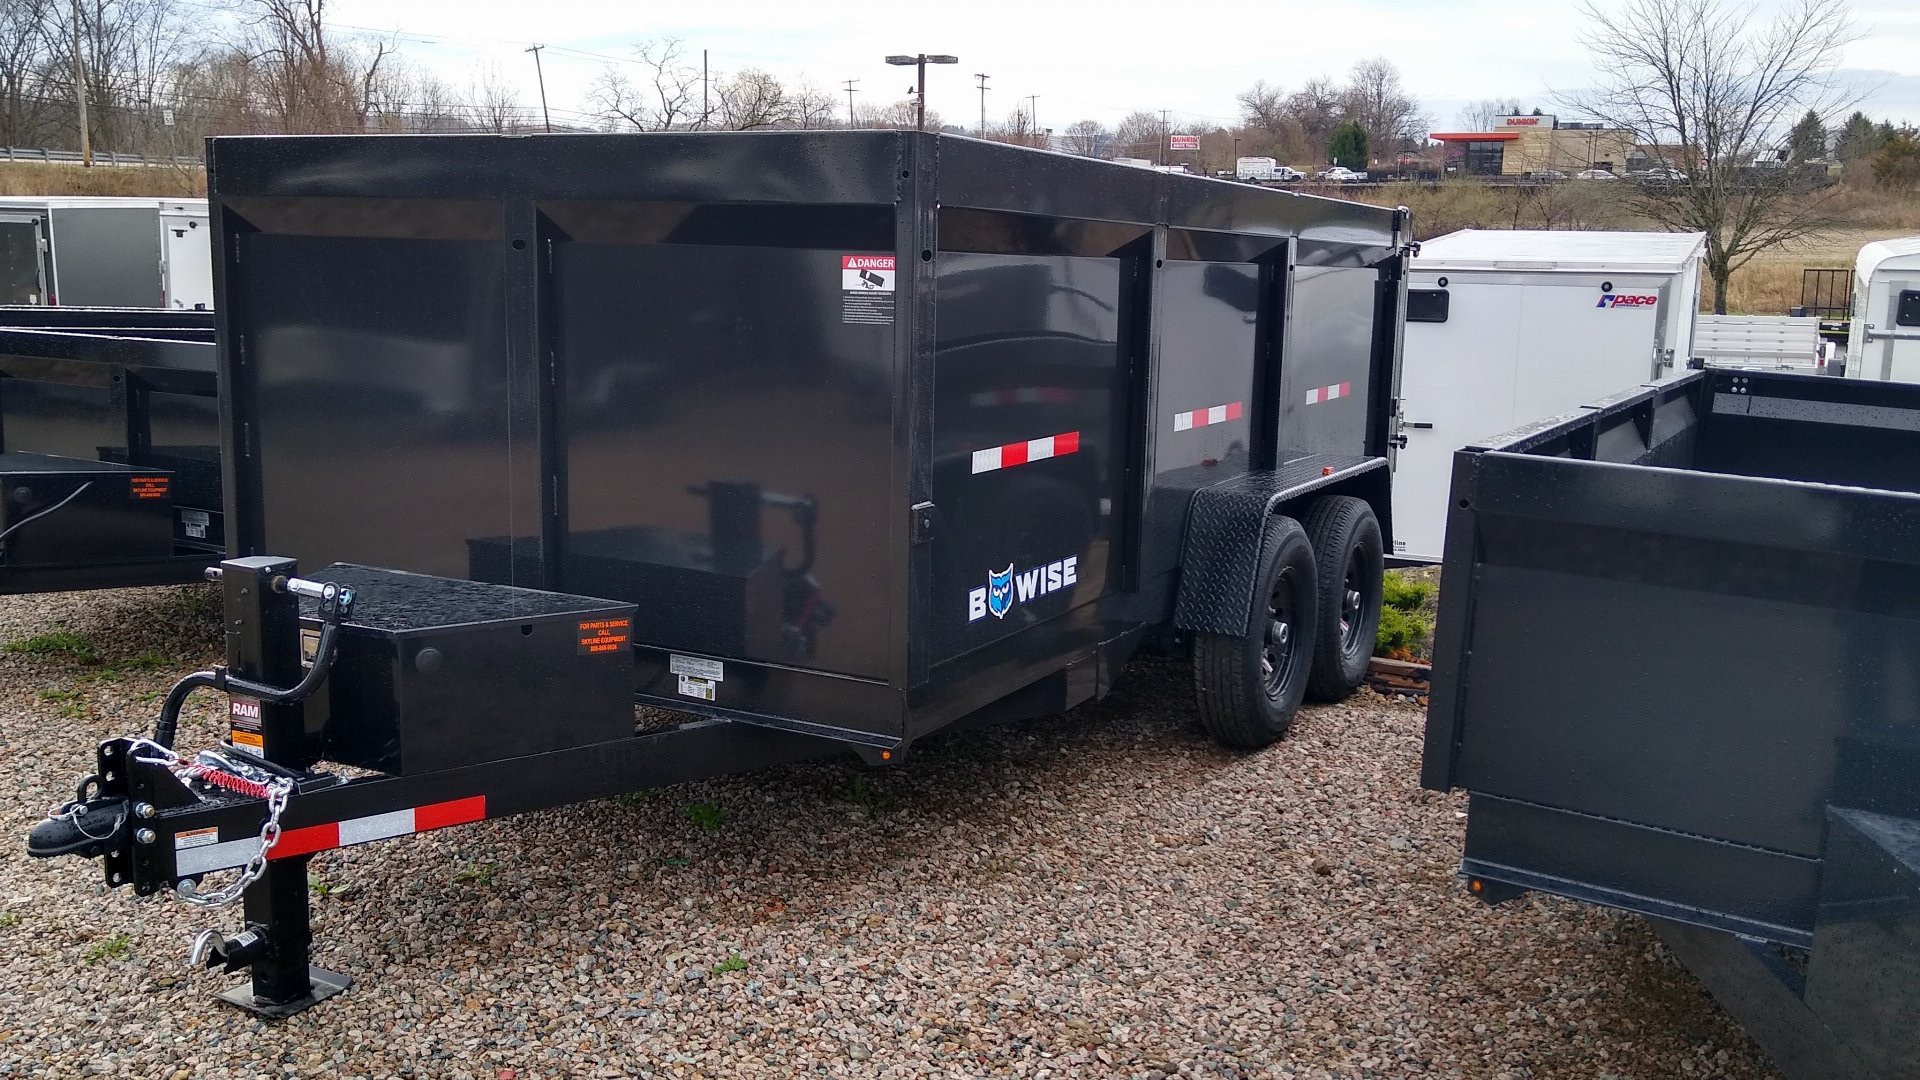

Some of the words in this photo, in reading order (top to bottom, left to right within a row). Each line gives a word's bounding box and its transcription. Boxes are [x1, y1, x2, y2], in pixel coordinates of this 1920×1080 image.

[857, 258, 894, 268] DANGER
[1611, 294, 1657, 308] pace
[609, 620, 629, 628] SERVICE
[232, 702, 258, 718] RAM
